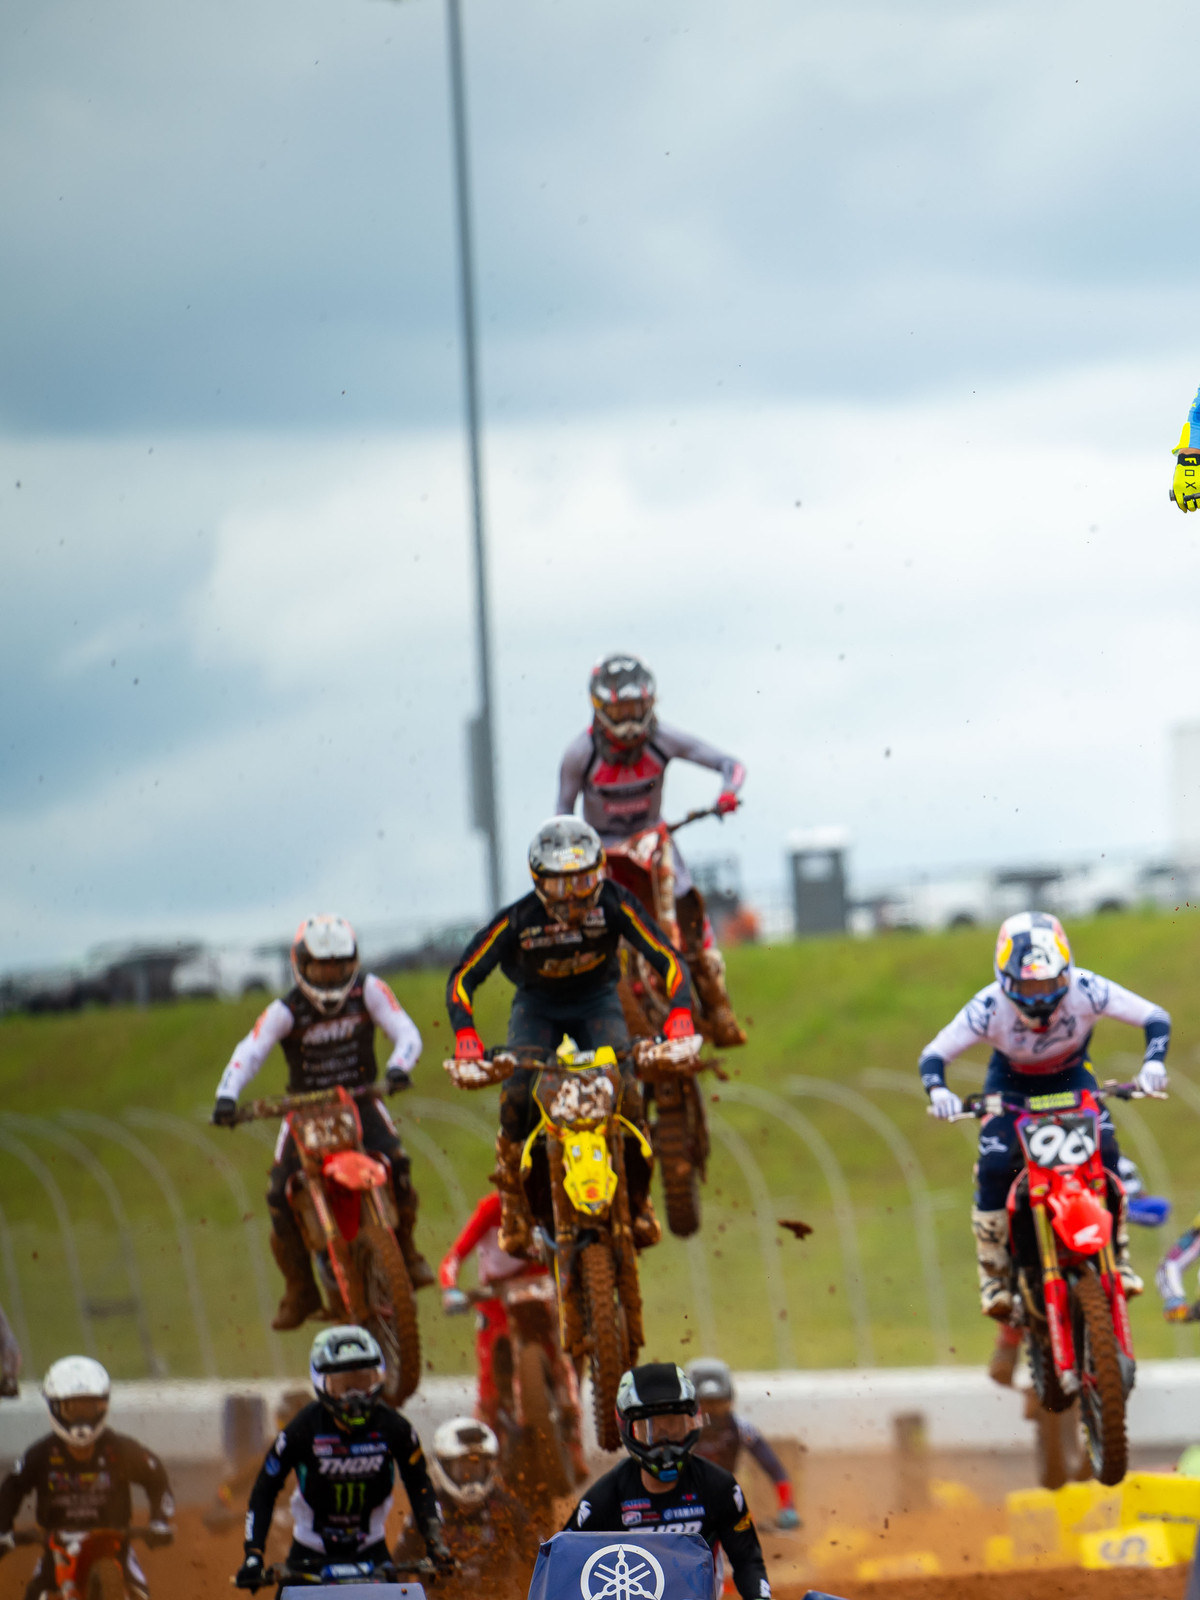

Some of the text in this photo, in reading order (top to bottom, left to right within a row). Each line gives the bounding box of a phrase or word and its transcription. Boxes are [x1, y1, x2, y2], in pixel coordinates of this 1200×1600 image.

[1185, 457, 1197, 489] FOX
[1029, 1124, 1095, 1166] 96
[319, 1454, 384, 1474] THOR
[673, 1506, 705, 1518] YAMAHA
